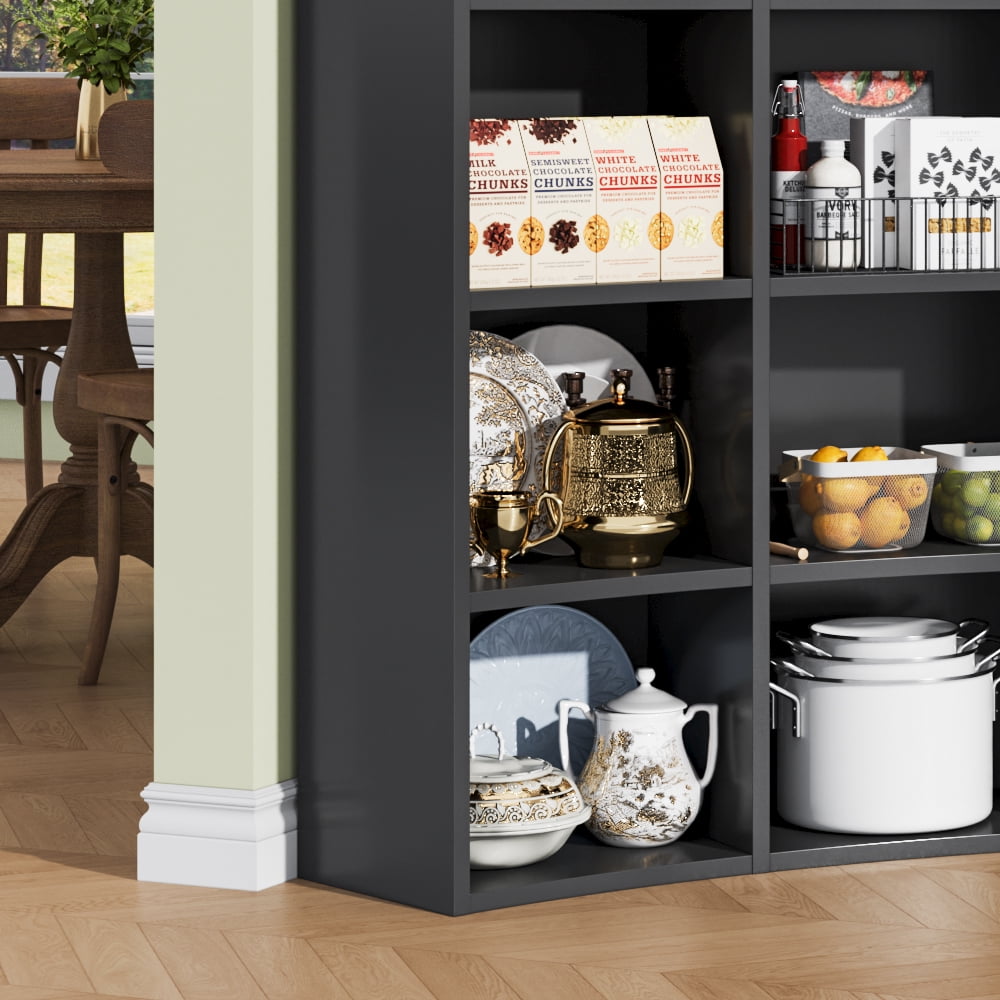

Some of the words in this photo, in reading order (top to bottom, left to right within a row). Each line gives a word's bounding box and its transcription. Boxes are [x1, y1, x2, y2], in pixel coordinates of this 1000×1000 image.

[595, 156, 636, 164] WHITE
[660, 154, 700, 162] WHITE
[534, 177, 593, 188] CHUNKS
[599, 175, 657, 186] CHUNKS
[664, 174, 721, 184] CHUNKS
